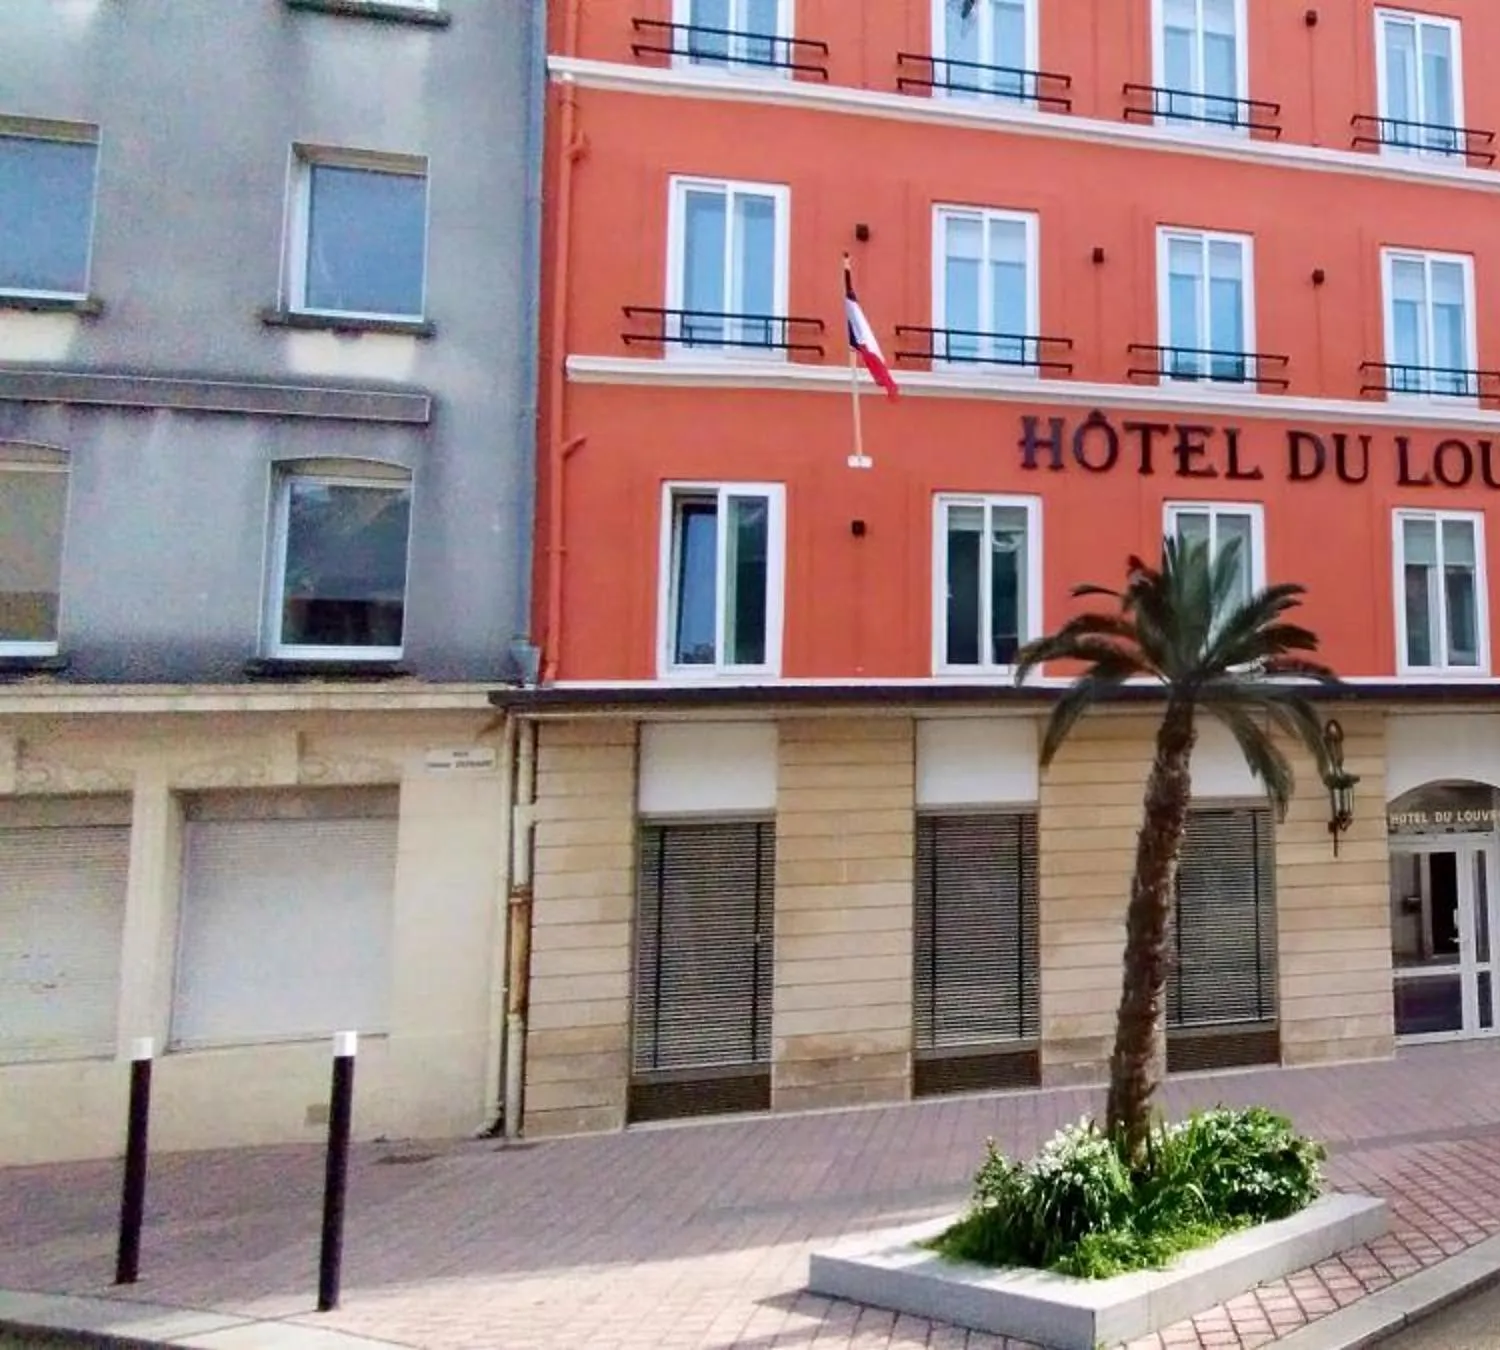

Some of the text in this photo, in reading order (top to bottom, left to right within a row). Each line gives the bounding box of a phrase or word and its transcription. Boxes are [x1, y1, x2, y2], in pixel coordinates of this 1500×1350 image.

[1018, 408, 1264, 480] HÔTEL
[1286, 430, 1372, 484] DU
[1435, 811, 1452, 823] DU
